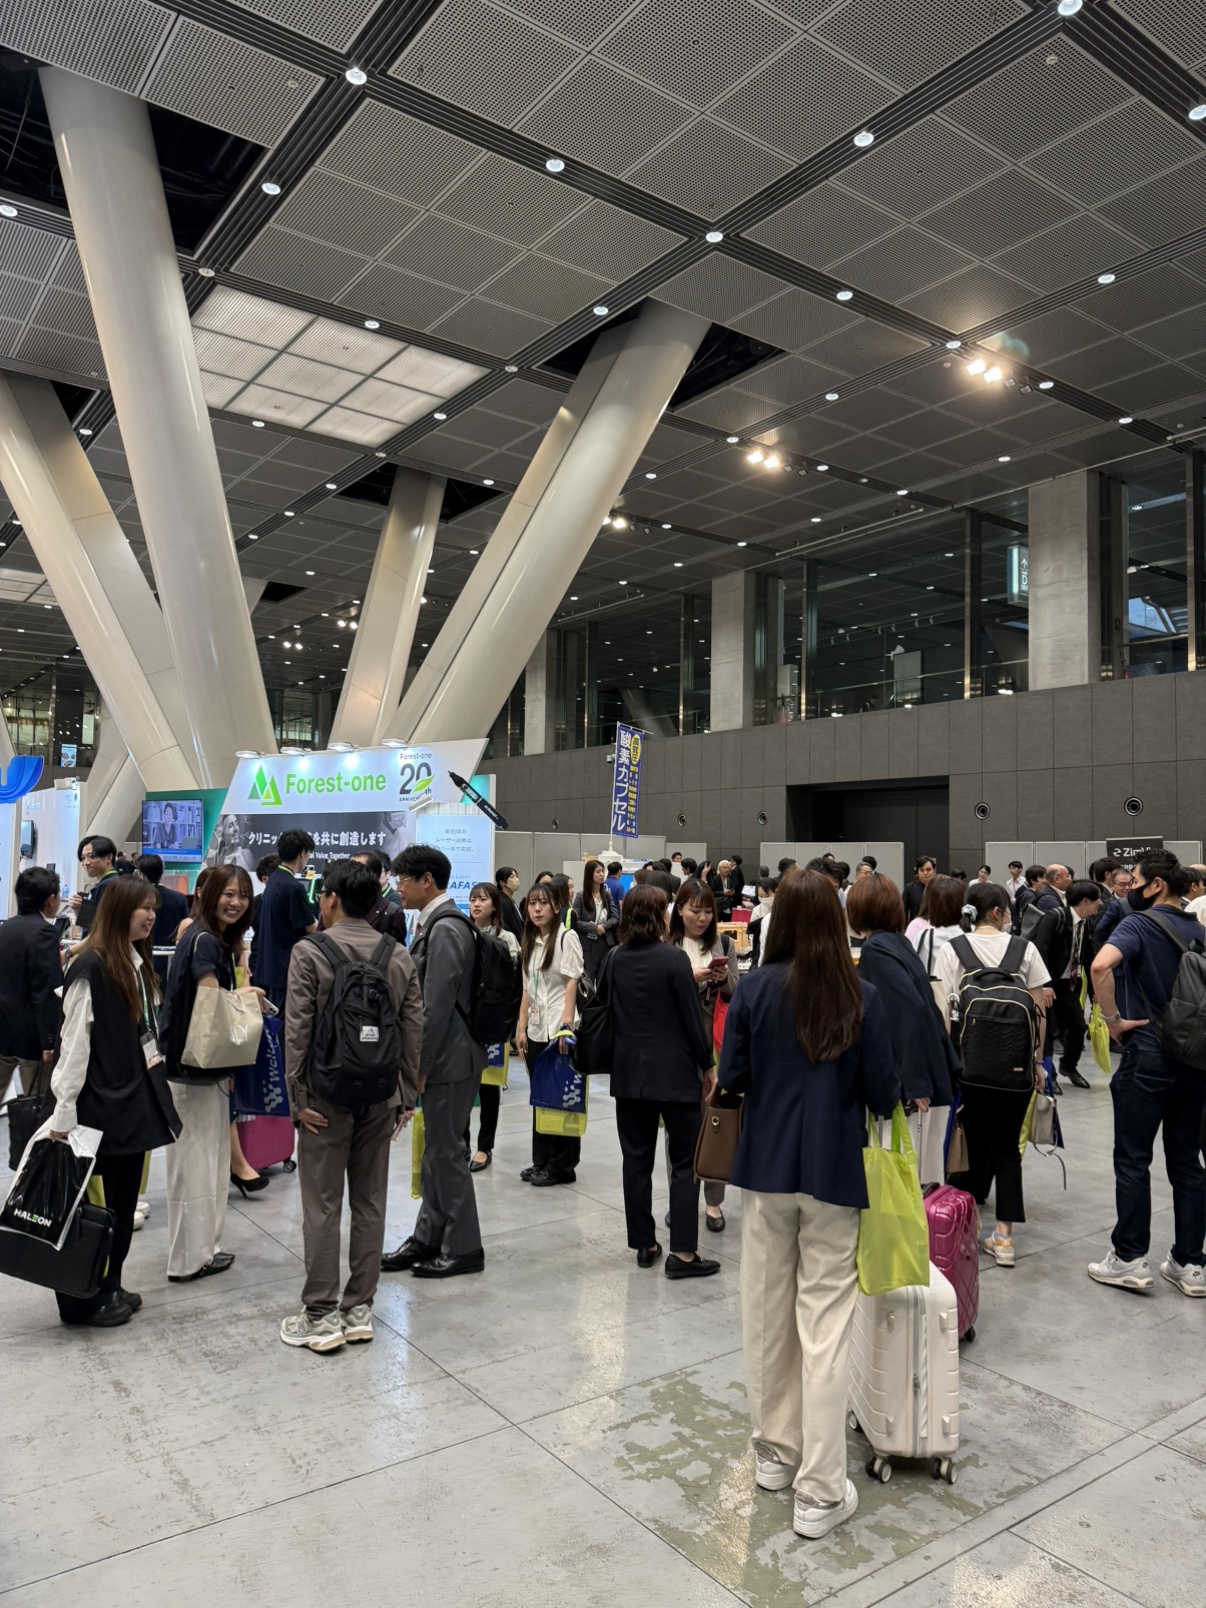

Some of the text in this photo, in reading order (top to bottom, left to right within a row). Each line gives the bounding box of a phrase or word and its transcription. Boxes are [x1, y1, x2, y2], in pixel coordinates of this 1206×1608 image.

[400, 752, 432, 760] Forest-one
[286, 772, 386, 794] Forest-one
[329, 852, 350, 860] Together
[14, 1208, 52, 1228] HALEON
